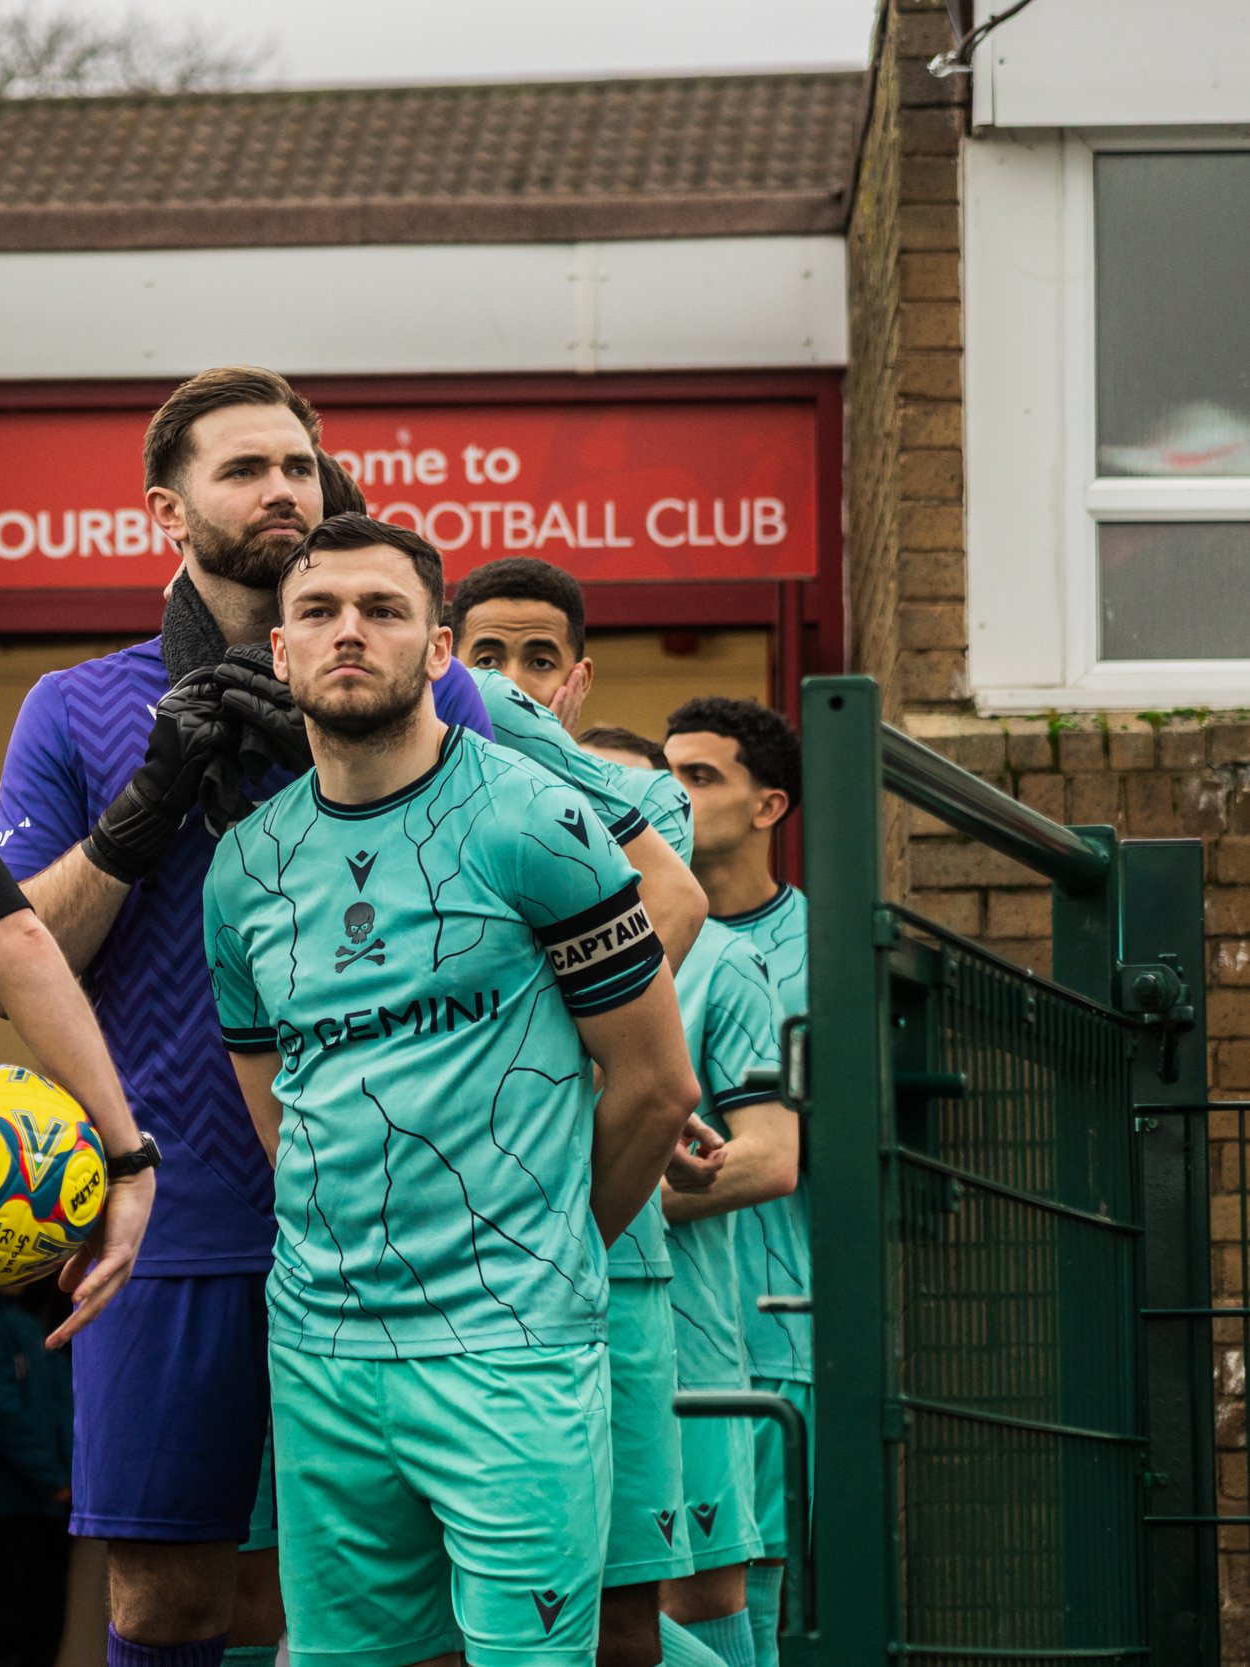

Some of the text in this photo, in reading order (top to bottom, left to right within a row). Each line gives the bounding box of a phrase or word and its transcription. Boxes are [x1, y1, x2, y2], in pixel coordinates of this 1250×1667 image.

[463, 444, 521, 485] to
[367, 499, 635, 551] OOTBALL
[646, 498, 788, 547] CLUB
[550, 909, 649, 970] CAPTAIN
[313, 989, 500, 1051] GEMINI
